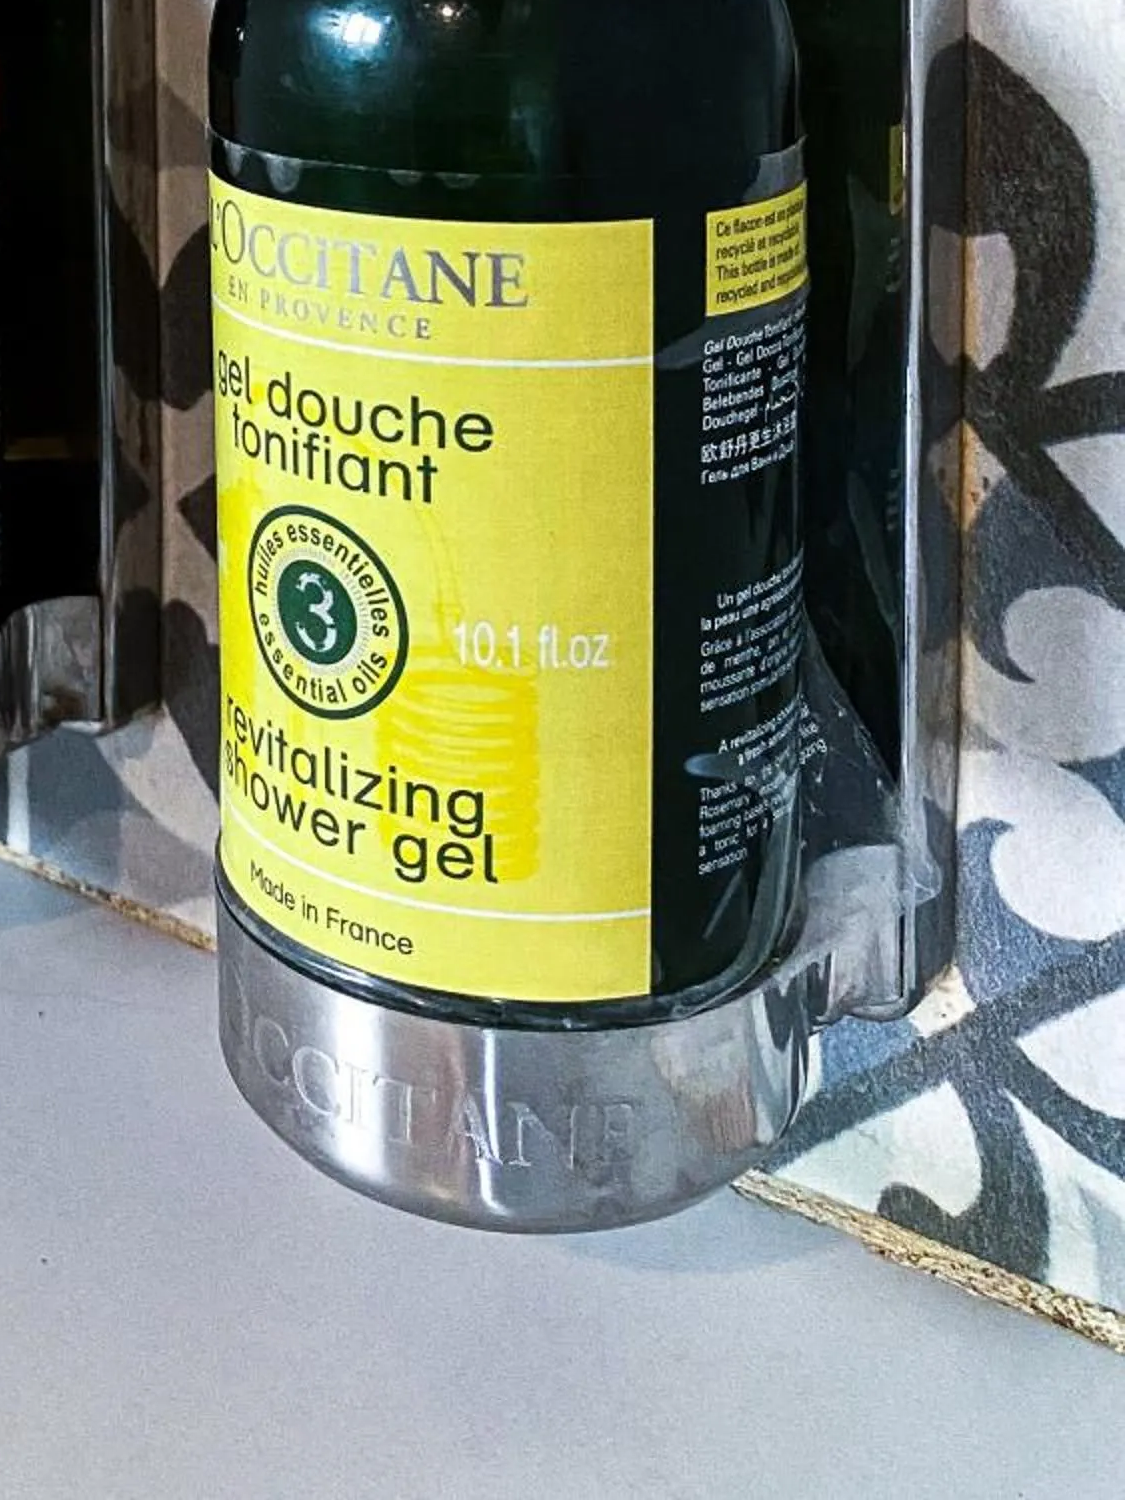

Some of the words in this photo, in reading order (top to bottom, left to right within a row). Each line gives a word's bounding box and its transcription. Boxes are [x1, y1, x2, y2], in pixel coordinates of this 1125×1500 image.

[716, 220, 732, 237] Ce
[715, 262, 740, 281] This
[716, 281, 759, 304] recycled
[227, 274, 249, 305] EN
[260, 287, 432, 341] PROVENCE
[704, 338, 724, 355] Gel
[726, 329, 764, 350] Douche
[702, 355, 724, 374] Gel
[736, 348, 754, 368] Gel
[702, 367, 763, 393] Tonificante
[218, 350, 253, 405] gel
[266, 371, 495, 453] douche
[702, 384, 765, 413] Belebendes
[702, 402, 759, 431] Douchegel
[232, 402, 439, 504] tonifiant
[254, 530, 285, 598] huiles
[286, 523, 391, 639] essentielles
[716, 592, 734, 609] Un
[735, 583, 752, 606] gel
[295, 571, 338, 652] 3
[713, 610, 741, 631] peau
[258, 612, 348, 705] essential
[351, 651, 389, 695] oils
[452, 620, 521, 669] 10.1
[538, 624, 610, 669] fl.oz
[700, 660, 716, 676] de
[718, 738, 729, 755] A
[226, 694, 485, 840] revitalizing
[699, 780, 738, 802] Thanks
[226, 739, 367, 856] shower
[392, 832, 499, 884] gel
[699, 813, 742, 840] foaming
[698, 845, 706, 858] a
[713, 832, 740, 852] tonic
[698, 847, 749, 876] sensation
[249, 858, 296, 911] Made
[302, 895, 319, 924] in
[325, 907, 415, 956] France
